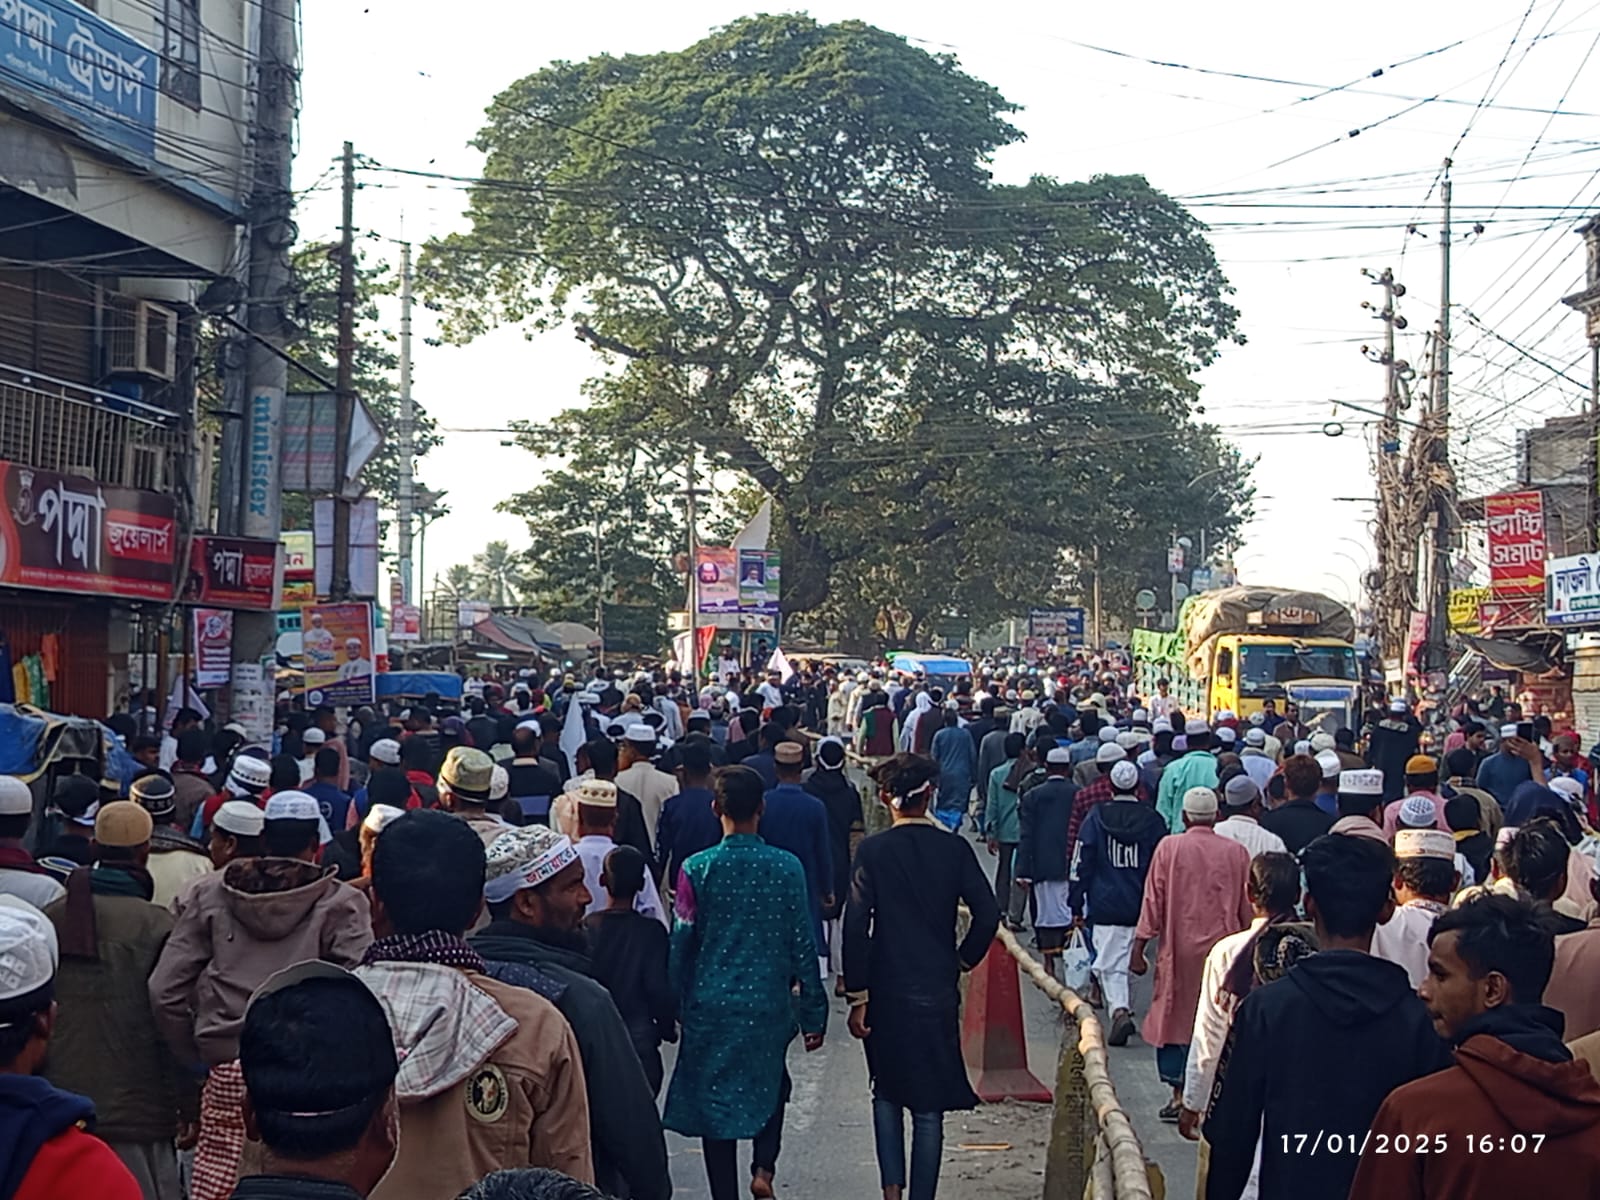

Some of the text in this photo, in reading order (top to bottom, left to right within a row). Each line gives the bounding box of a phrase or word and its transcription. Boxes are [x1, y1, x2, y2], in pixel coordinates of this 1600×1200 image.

[38, 480, 171, 573] পদ্মা জুয়েলার্স
[213, 547, 244, 586] পদ্মা
